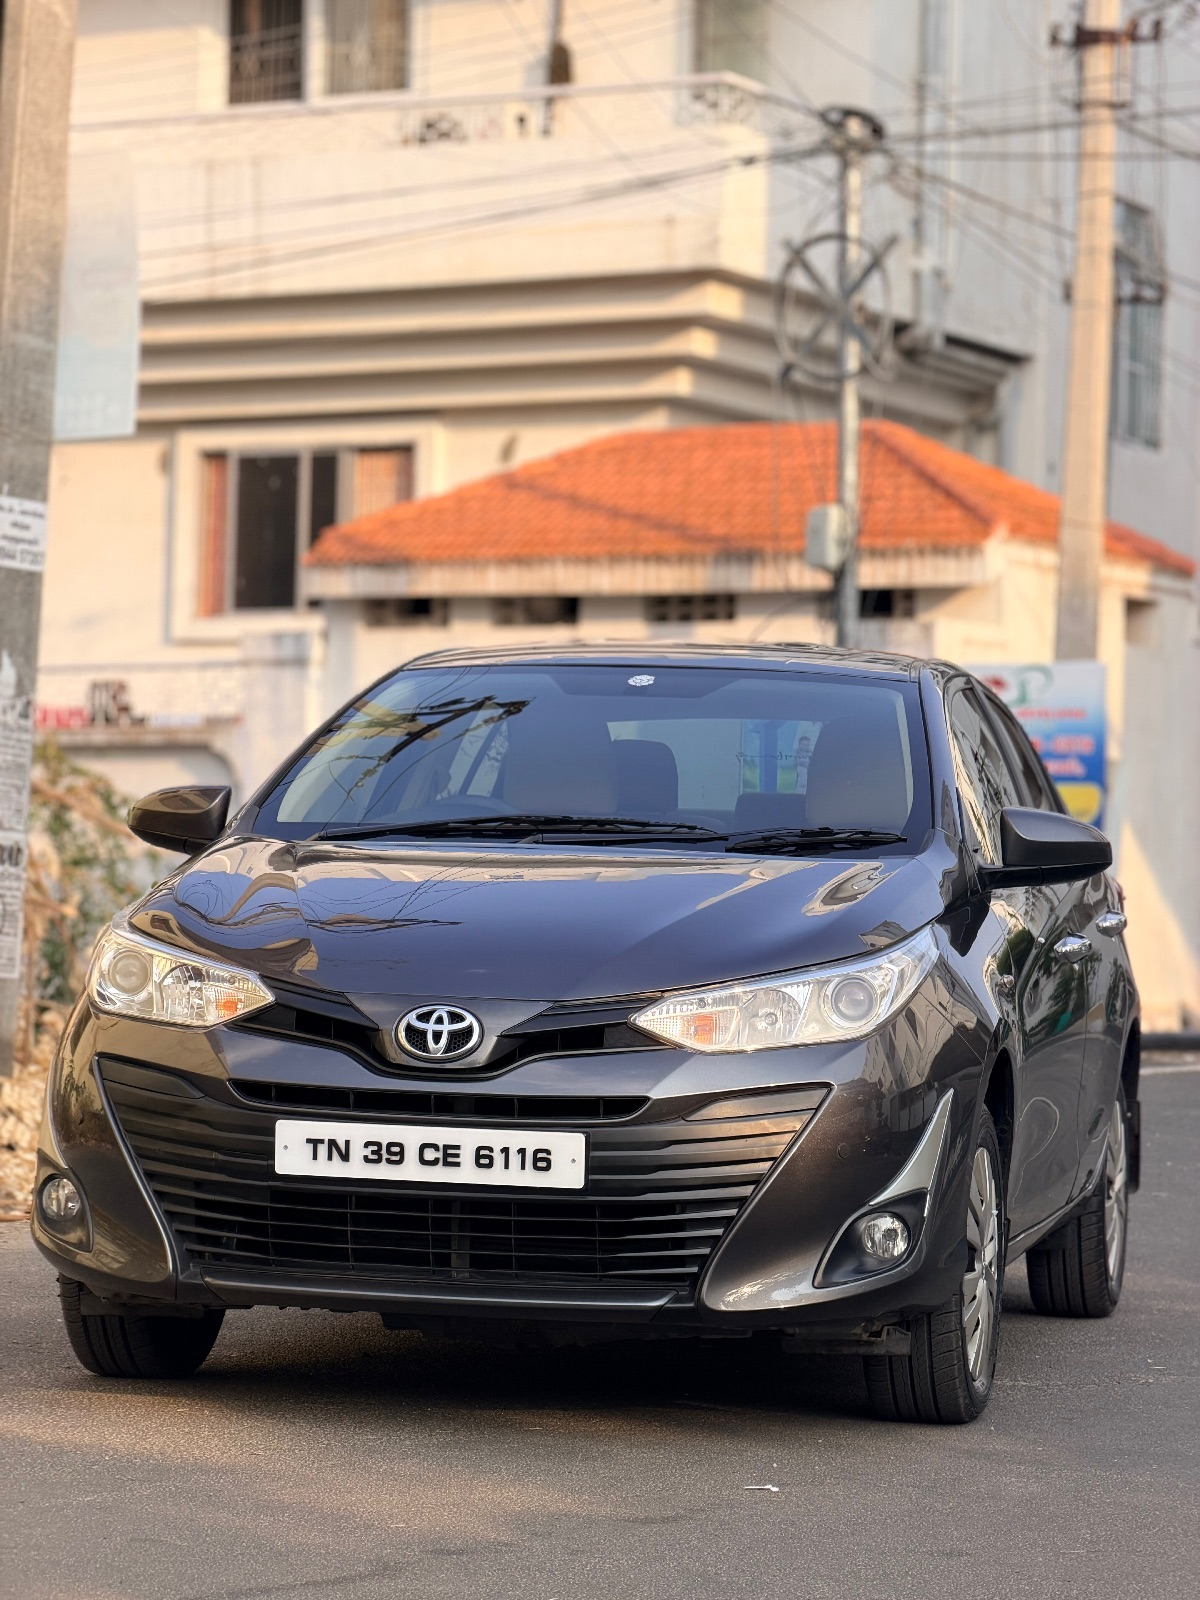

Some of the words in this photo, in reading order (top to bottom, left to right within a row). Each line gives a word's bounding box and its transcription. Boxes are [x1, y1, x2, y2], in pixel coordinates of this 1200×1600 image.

[305, 1138, 351, 1162] TN
[362, 1141, 405, 1166] 39
[418, 1143, 461, 1168] CE
[474, 1145, 552, 1172] 6116
